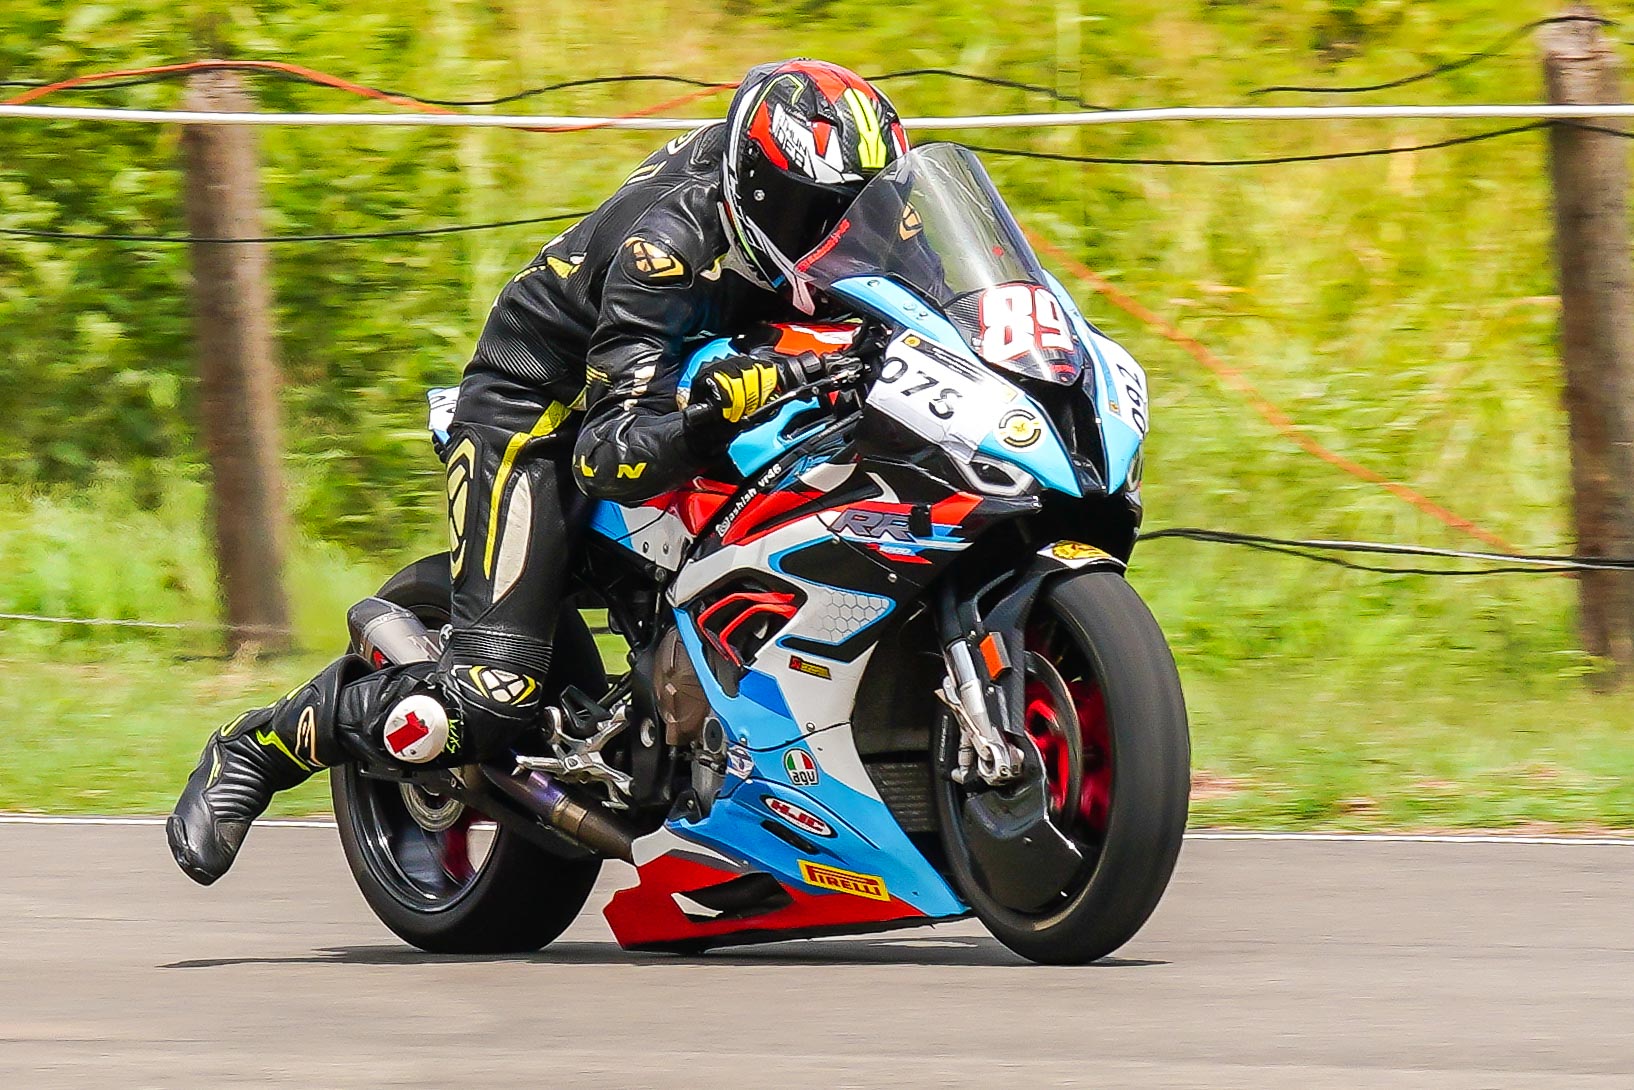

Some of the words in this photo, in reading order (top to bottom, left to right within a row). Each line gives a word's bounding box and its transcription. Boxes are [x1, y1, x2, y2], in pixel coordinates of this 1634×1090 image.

[978, 282, 1075, 362] 89
[757, 463, 782, 487] vr46
[770, 799, 826, 833] HJC
[804, 864, 883, 897] PIRELLI
